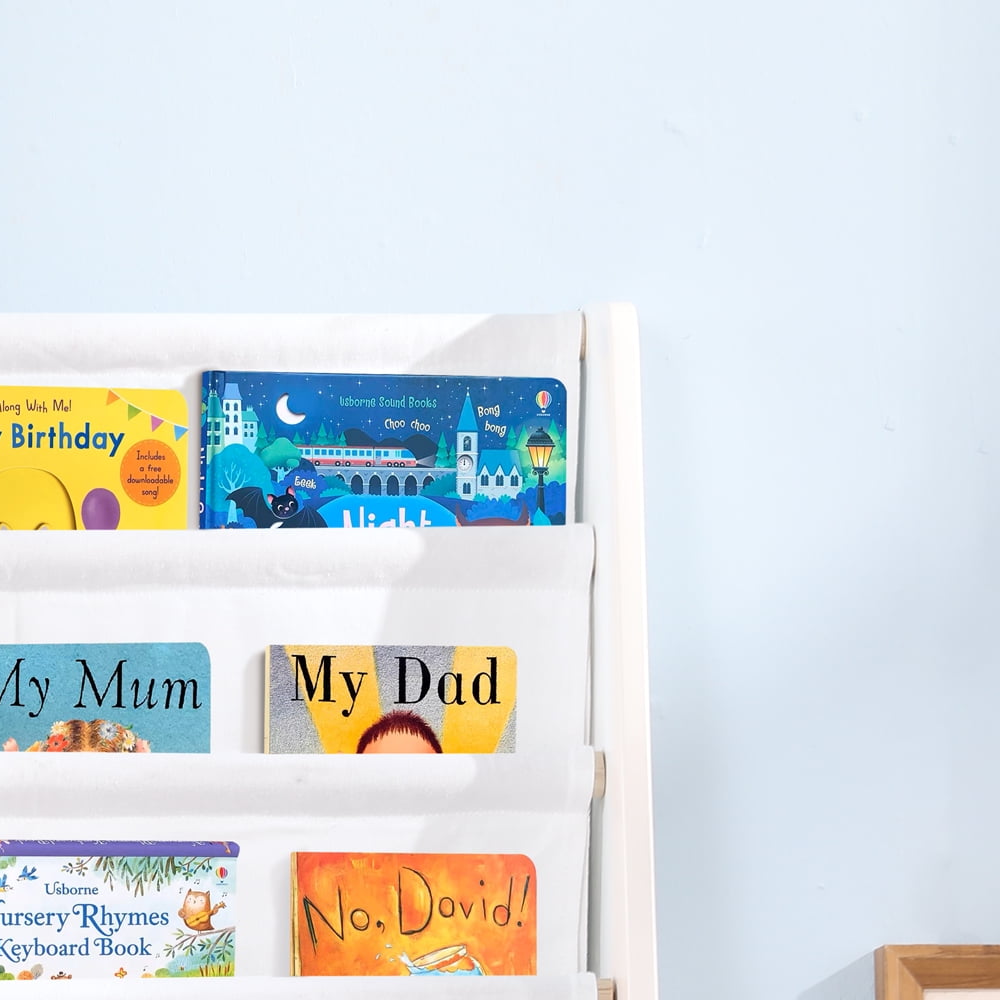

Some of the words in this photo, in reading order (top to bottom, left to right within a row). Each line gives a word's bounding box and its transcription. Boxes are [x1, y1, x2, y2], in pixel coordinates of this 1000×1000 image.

[26, 399, 48, 413] With
[53, 399, 72, 412] Me!
[339, 395, 377, 408] Usborne
[379, 395, 406, 408] Sound
[408, 396, 438, 409] Books
[477, 404, 500, 418] Bong
[384, 418, 406, 430] Choo
[410, 419, 431, 432] choo
[484, 420, 507, 438] bong
[11, 421, 125, 457] Birthday
[137, 450, 165, 460] Includes
[148, 464, 161, 472] free
[127, 474, 174, 484] downloadable
[142, 486, 159, 500] song!
[74, 659, 202, 709] Mum
[291, 654, 368, 717] My
[394, 656, 500, 706] Dad
[44, 881, 99, 895] Usborne
[72, 903, 169, 936] Rhymes
[303, 884, 386, 955] No,
[93, 937, 152, 957] Book
